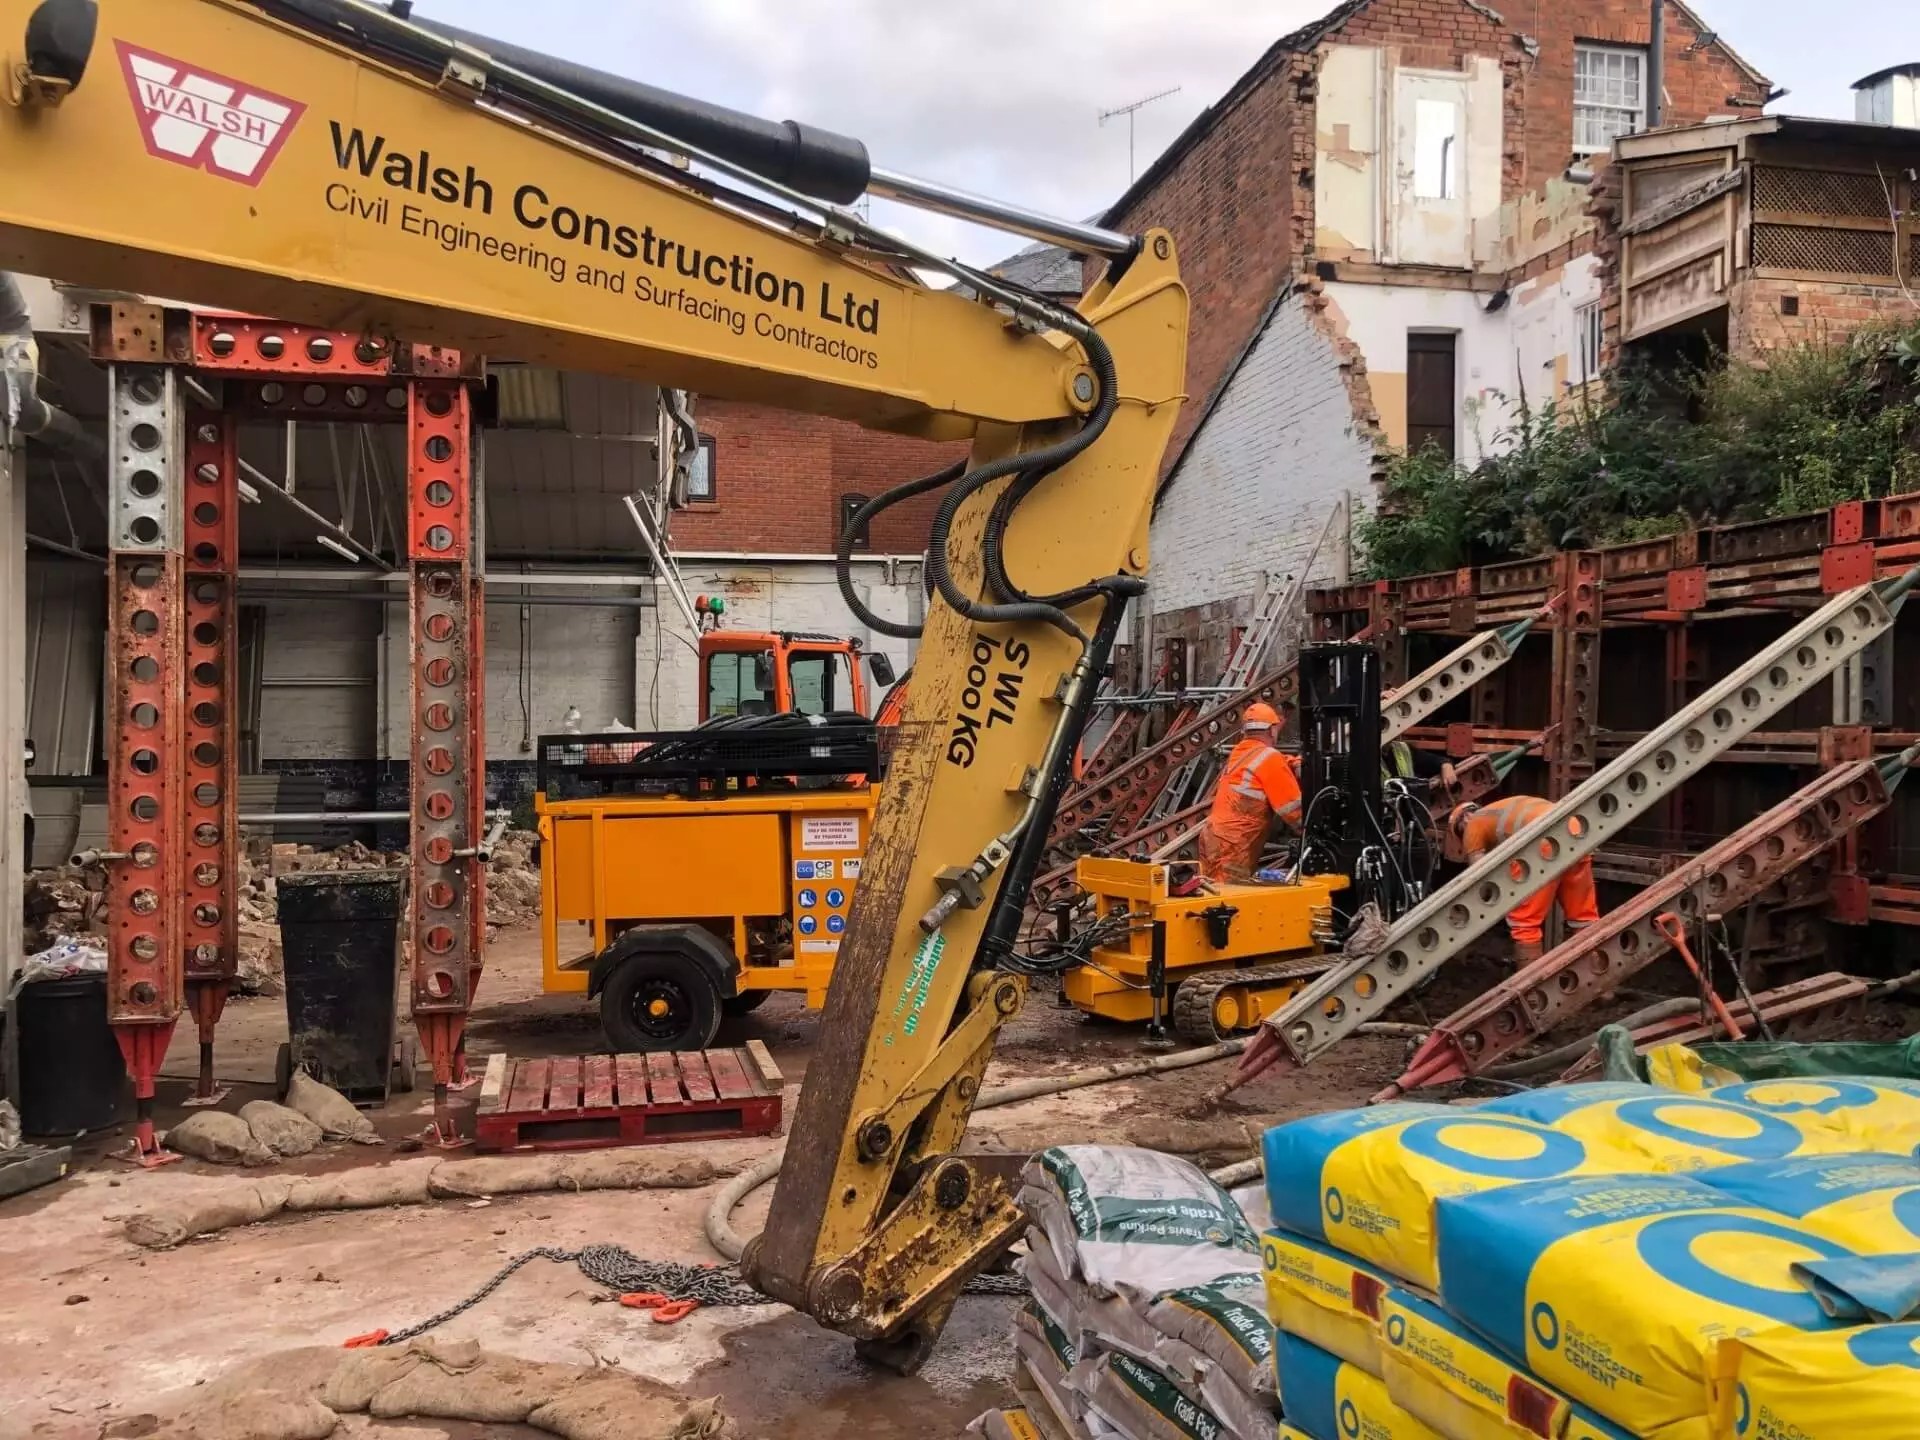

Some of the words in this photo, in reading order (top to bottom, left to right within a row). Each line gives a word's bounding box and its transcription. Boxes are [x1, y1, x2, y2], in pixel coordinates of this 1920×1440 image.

[145, 84, 267, 143] WALSH
[328, 120, 493, 215] Walsh
[513, 184, 805, 312] Construction
[820, 282, 879, 335] Ltd
[325, 182, 389, 225] Civil
[401, 205, 567, 283] Engineering
[576, 262, 625, 294] and
[634, 275, 746, 335] Surfacing
[754, 312, 879, 370] Contractors
[986, 636, 1030, 729] SWL
[913, 933, 946, 1009] Automatic
[1119, 1222, 1166, 1235] Perkins
[1167, 1226, 1206, 1240] Travis
[1181, 1205, 1226, 1222] Trade
[1223, 1307, 1254, 1337] Trade
[1246, 1329, 1274, 1356] Pack
[1406, 1341, 1468, 1385] MASTERCRETE
[1468, 1377, 1506, 1407] CEMENT
[1564, 1332, 1644, 1386] MASTERCRETE
[1564, 1347, 1617, 1391] CEMENT
[1173, 1396, 1199, 1425] Trade
